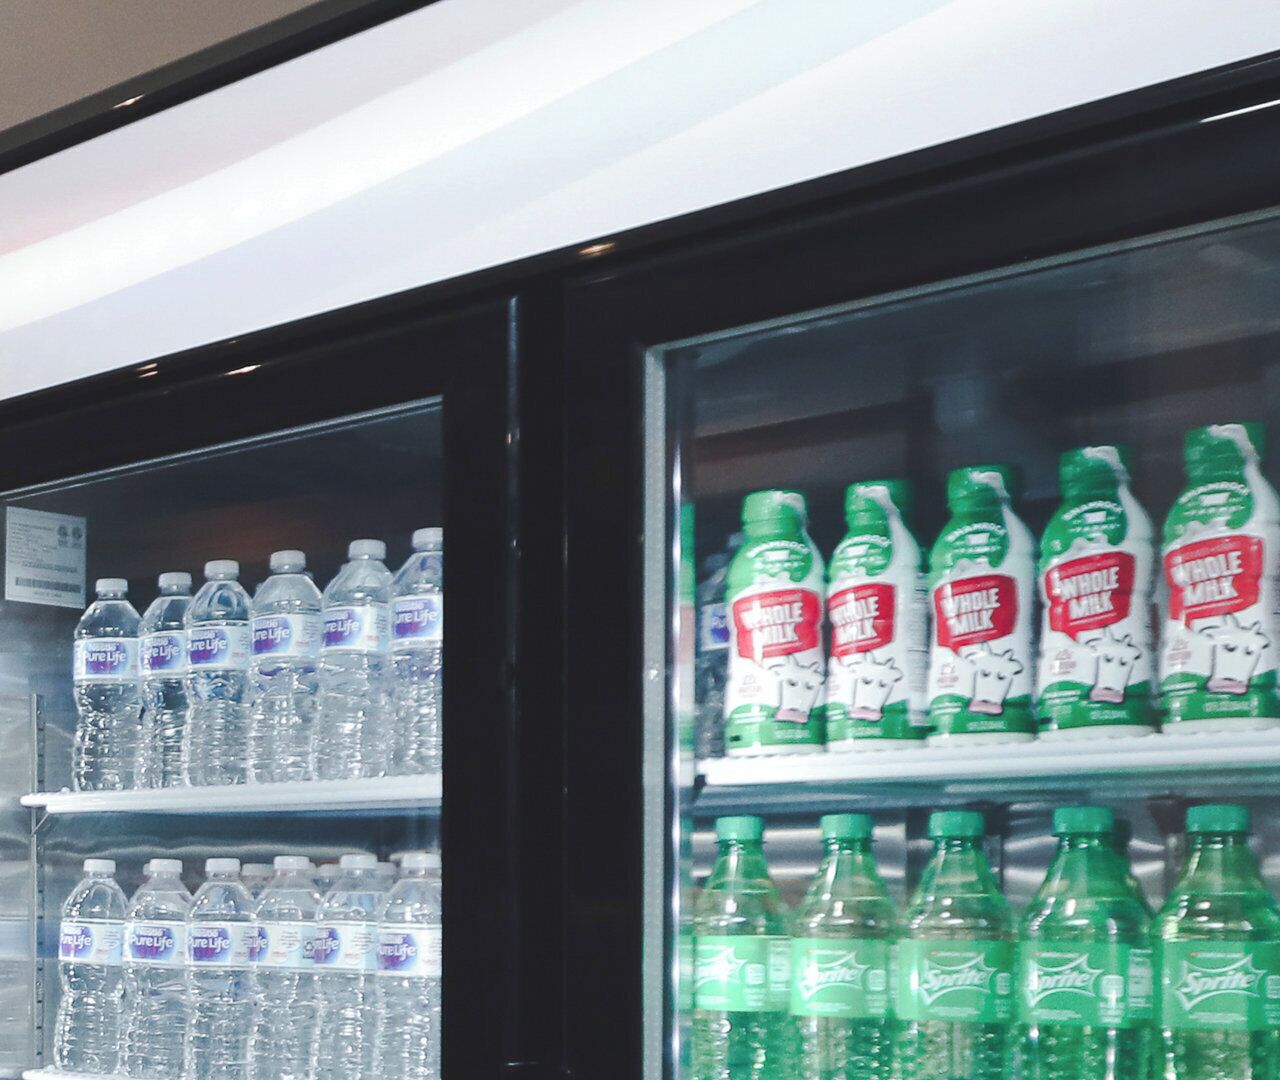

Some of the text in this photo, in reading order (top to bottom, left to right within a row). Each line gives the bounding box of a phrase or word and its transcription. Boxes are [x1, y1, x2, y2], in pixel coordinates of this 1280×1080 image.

[1170, 550, 1244, 588] WHOLE
[1058, 566, 1120, 603] WHOLE
[1184, 576, 1239, 606] MILK
[829, 596, 880, 628] WHOLE
[940, 587, 1000, 618] WHOLE
[1068, 591, 1115, 619] MILK
[414, 609, 438, 626] Life
[740, 601, 804, 631] WHOLE
[946, 608, 994, 637] MILK
[270, 627, 290, 643] Life
[338, 619, 360, 636] Life
[160, 644, 182, 660] Life
[206, 637, 227, 654] Life
[85, 650, 127, 666] Pure Life
[73, 935, 92, 950] Life
[130, 936, 175, 951] Pure Life
[209, 938, 231, 954] Life
[394, 943, 417, 960] Life
[922, 967, 988, 991] Sprite
[1180, 970, 1257, 995] Sprite
